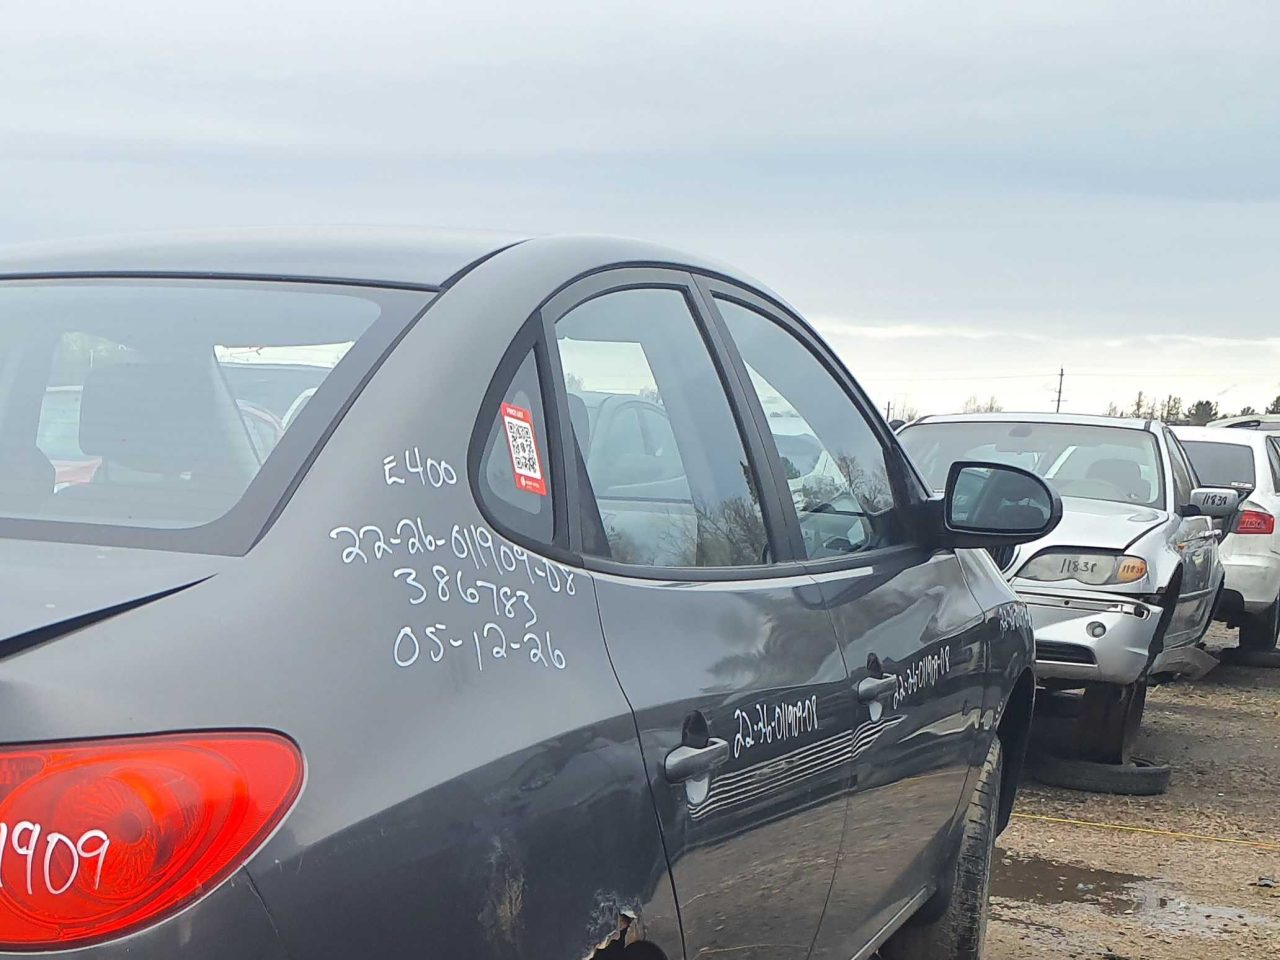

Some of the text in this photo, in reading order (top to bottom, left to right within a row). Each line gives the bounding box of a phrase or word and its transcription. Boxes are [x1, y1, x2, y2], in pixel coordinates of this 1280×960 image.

[383, 447, 457, 487] E400
[329, 517, 576, 595] 22-26-011909-08
[393, 565, 538, 628] 386783
[393, 622, 566, 671] 05-12-26
